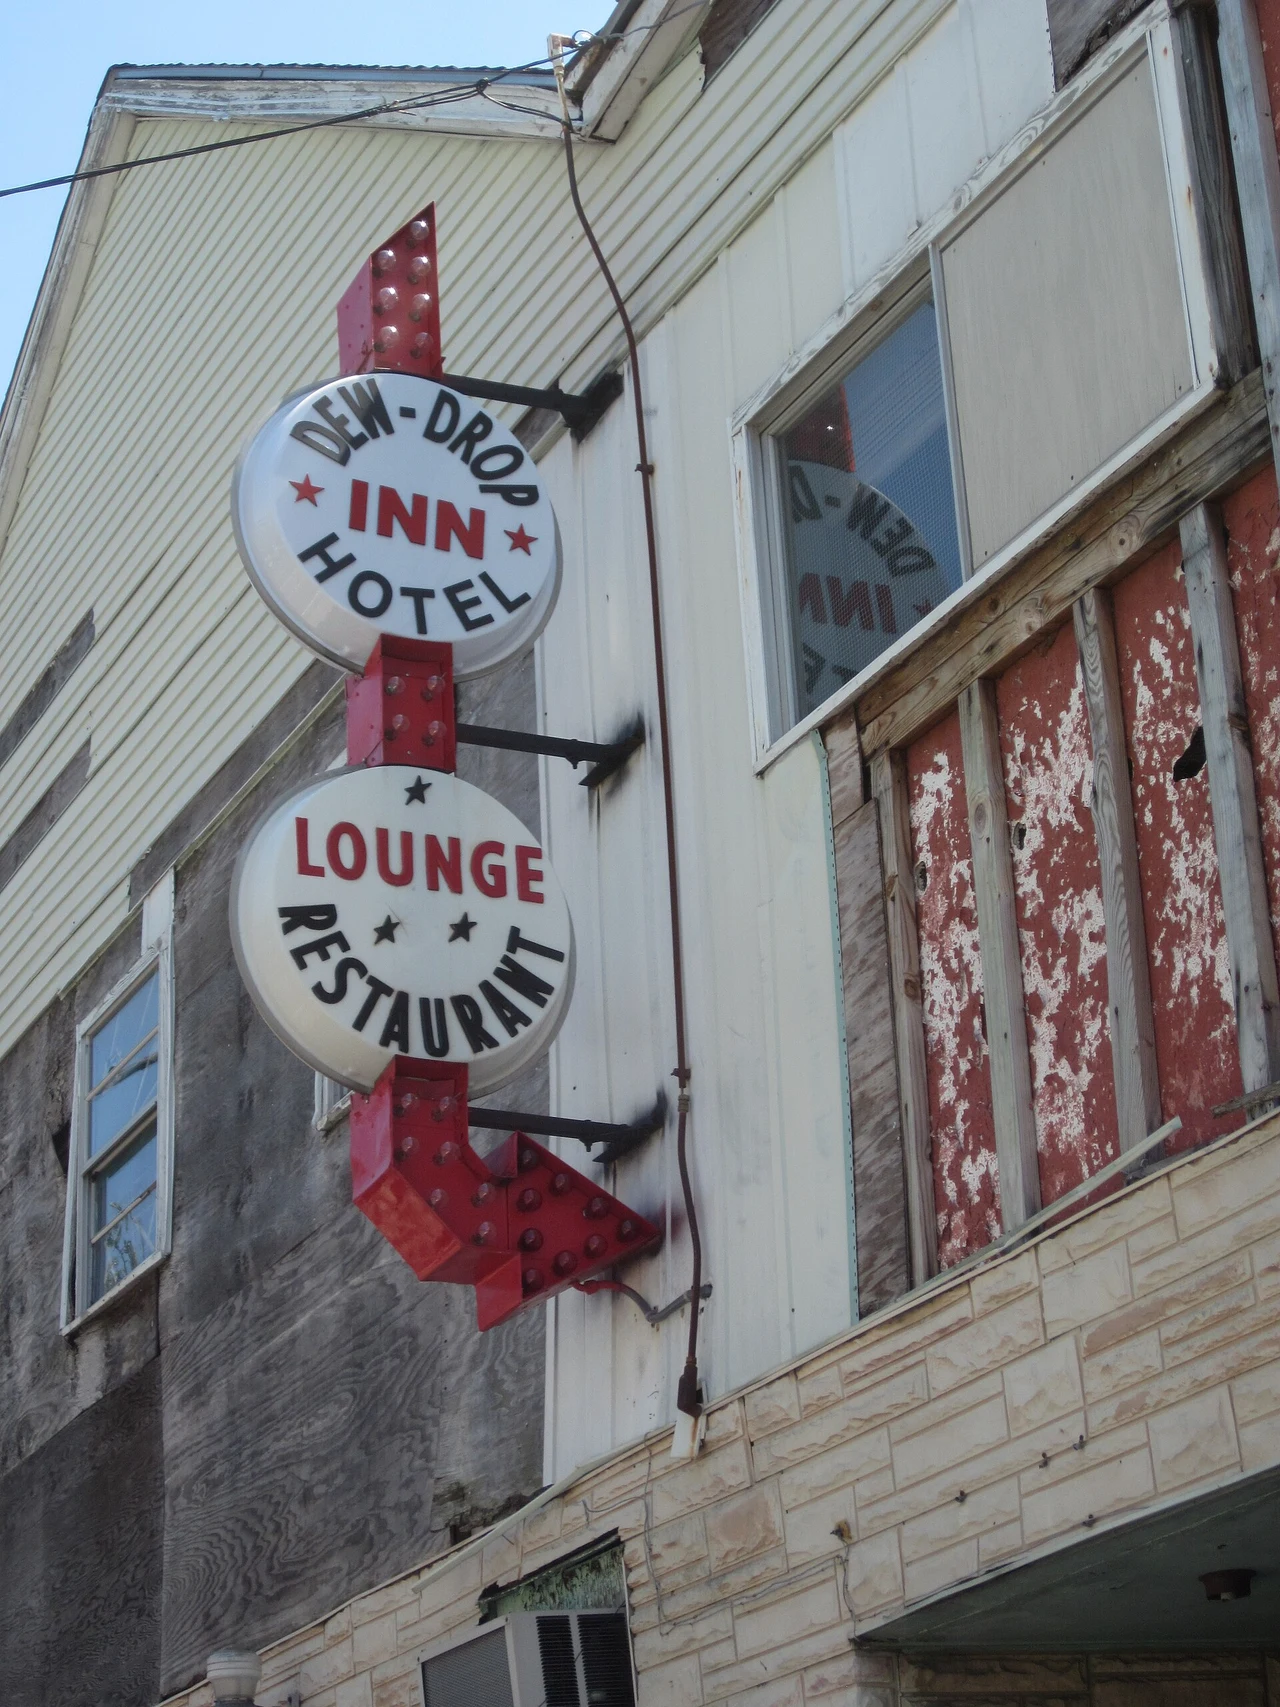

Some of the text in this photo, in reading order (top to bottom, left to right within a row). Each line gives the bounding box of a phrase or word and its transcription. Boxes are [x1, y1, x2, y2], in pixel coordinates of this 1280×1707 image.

[289, 378, 540, 507] DEW-DROP
[348, 478, 486, 560] INN
[296, 532, 532, 635] HOTEL
[294, 816, 545, 905] LOUNGE
[277, 903, 565, 1058] RESTAURANT
